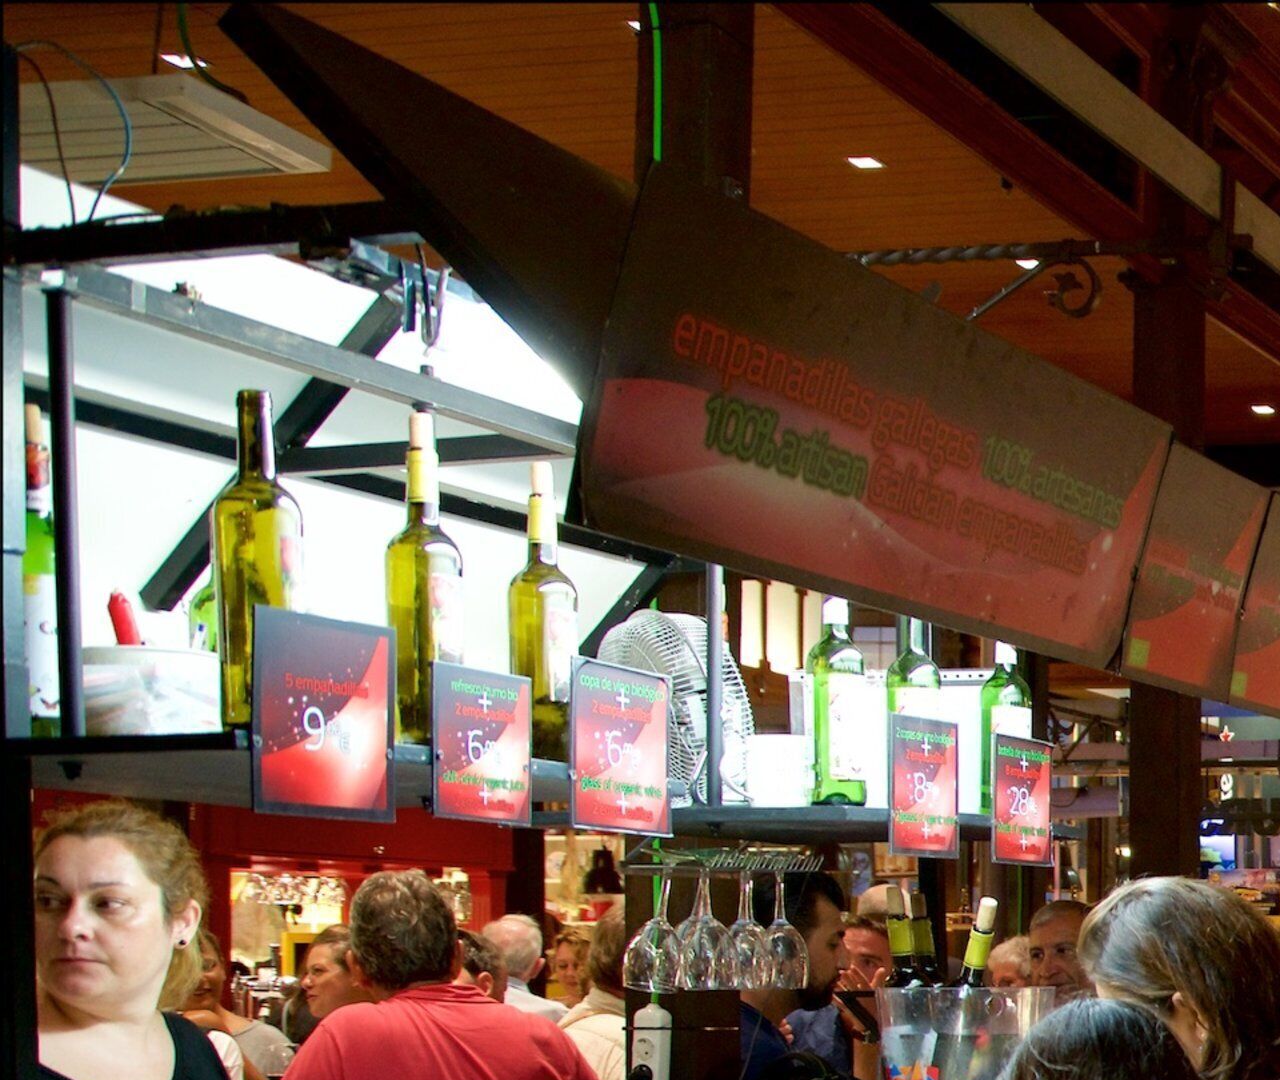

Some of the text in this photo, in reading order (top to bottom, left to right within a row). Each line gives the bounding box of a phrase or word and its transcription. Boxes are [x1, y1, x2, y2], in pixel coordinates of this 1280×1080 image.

[673, 312, 876, 430] empanadillas
[871, 395, 980, 473] gallegas
[775, 429, 869, 500] artisan
[285, 672, 294, 688] 5
[579, 675, 600, 689] copa
[601, 677, 612, 691] de
[303, 706, 326, 751] 9
